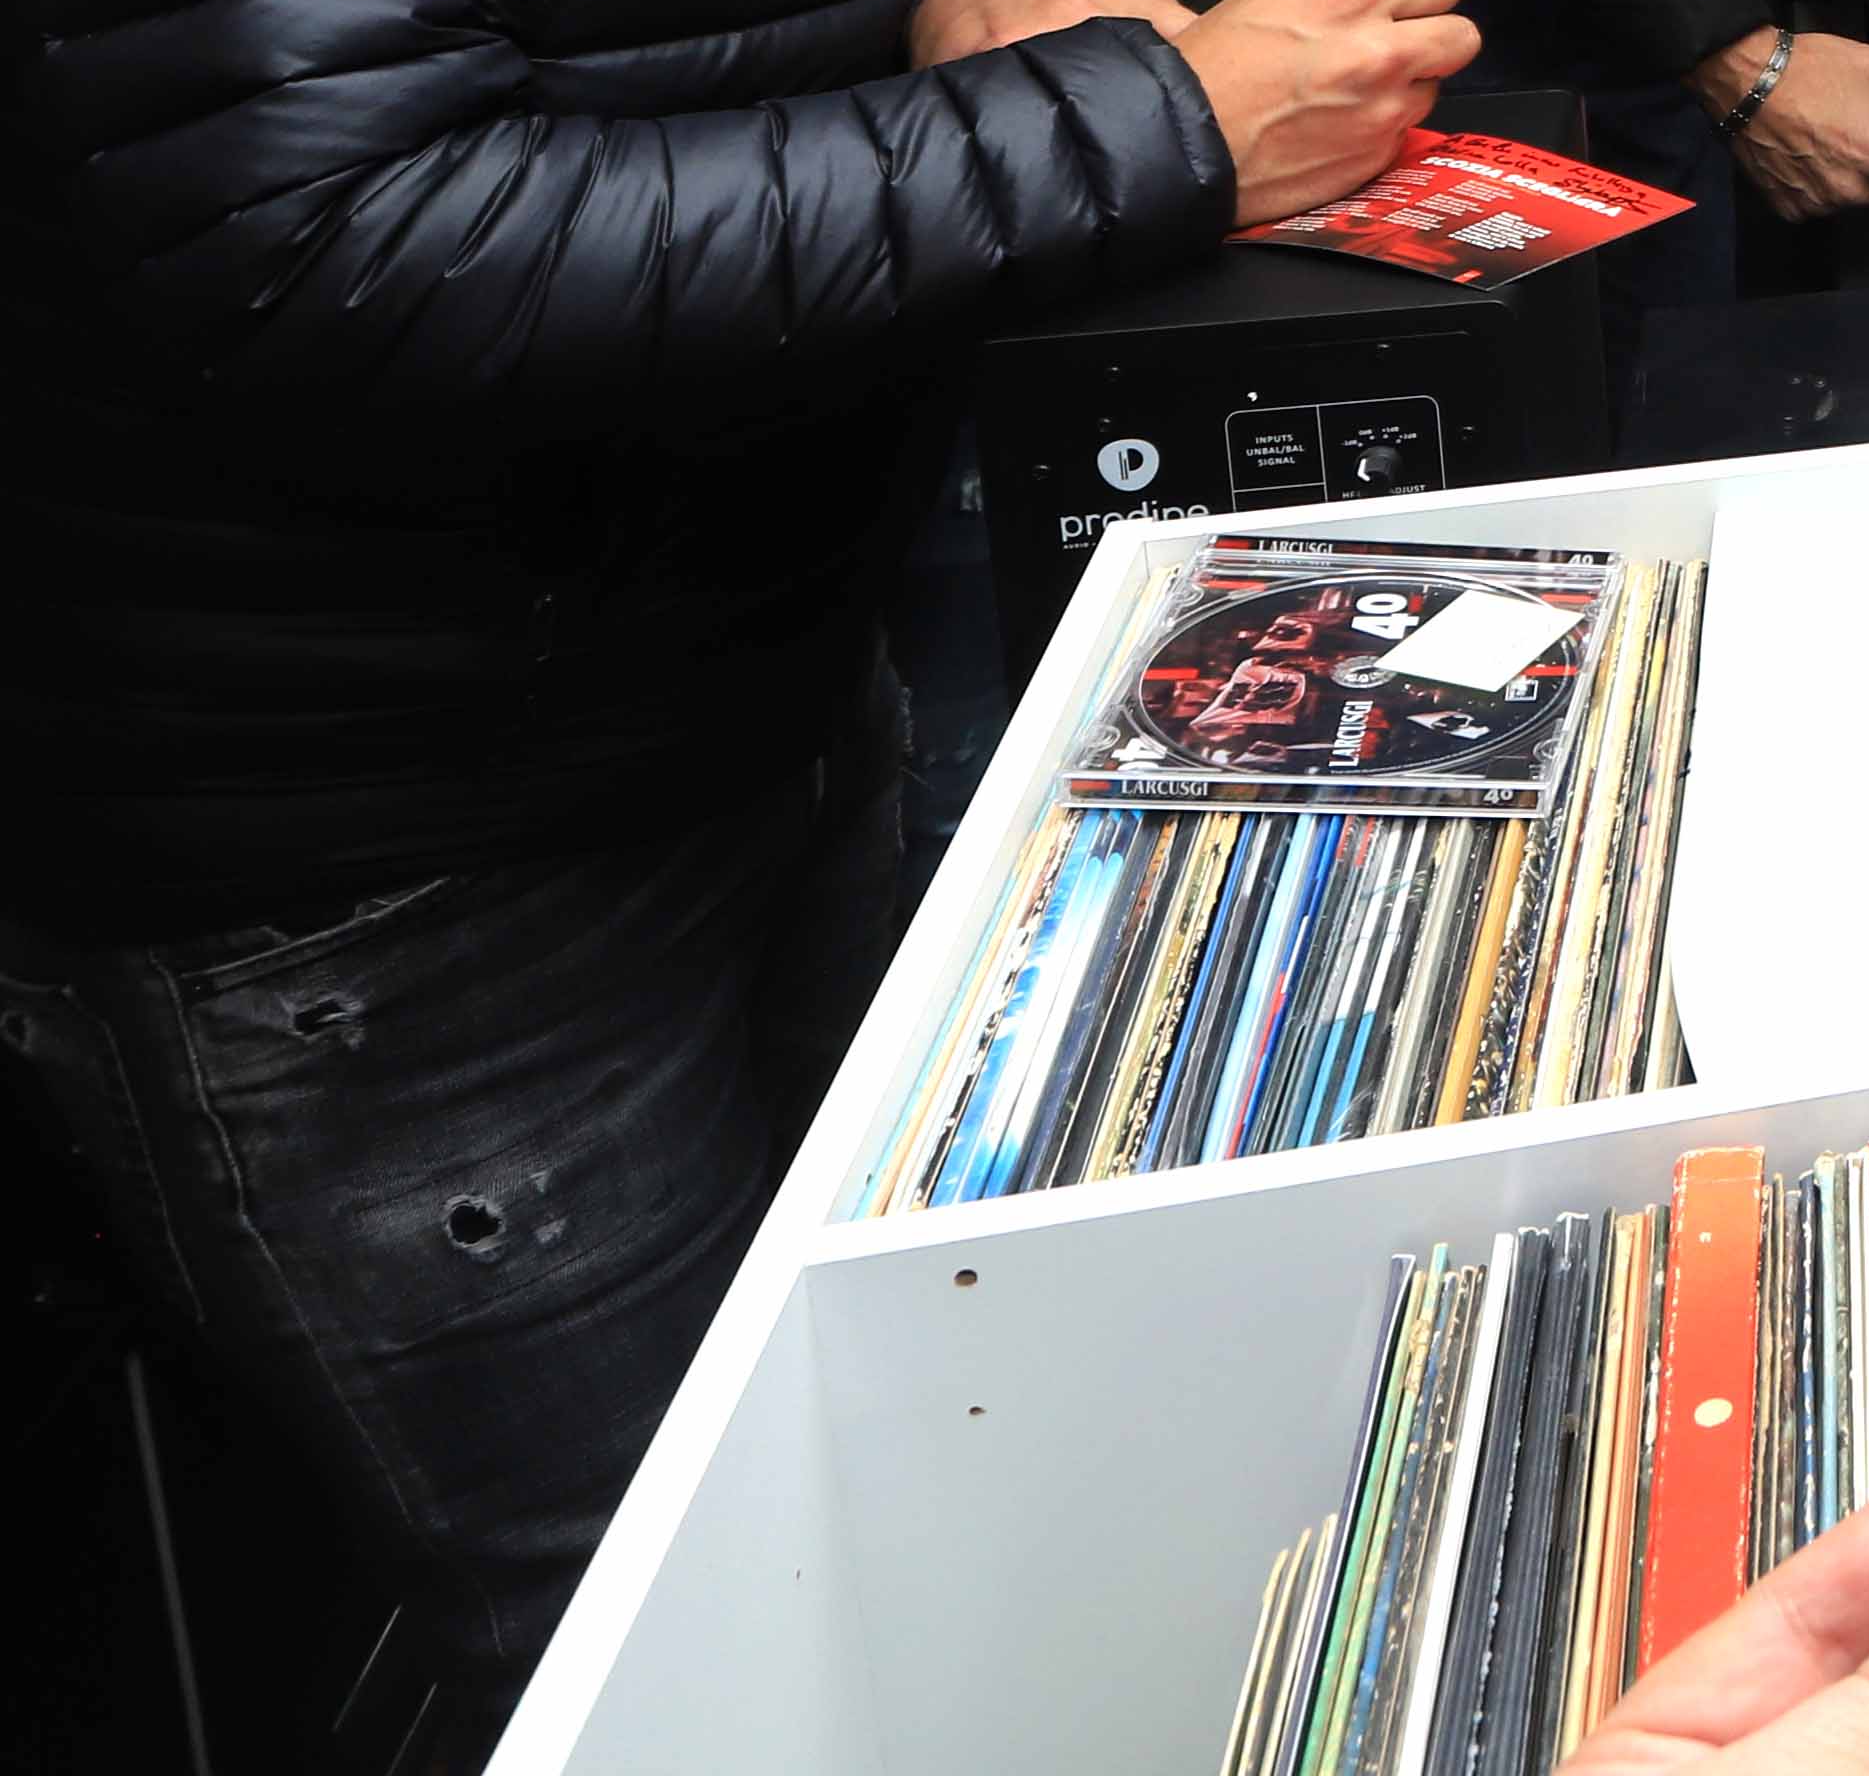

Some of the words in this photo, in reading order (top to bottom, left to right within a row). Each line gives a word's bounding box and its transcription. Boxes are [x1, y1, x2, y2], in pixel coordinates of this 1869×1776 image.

[1420, 155, 1504, 180] SCOZIA
[1254, 432, 1294, 445] INPUTS
[1245, 443, 1305, 458] UNBAL/BAL
[1257, 454, 1296, 468] SIGNAL
[1352, 593, 1420, 640] 40
[1482, 788, 1513, 805] 40
